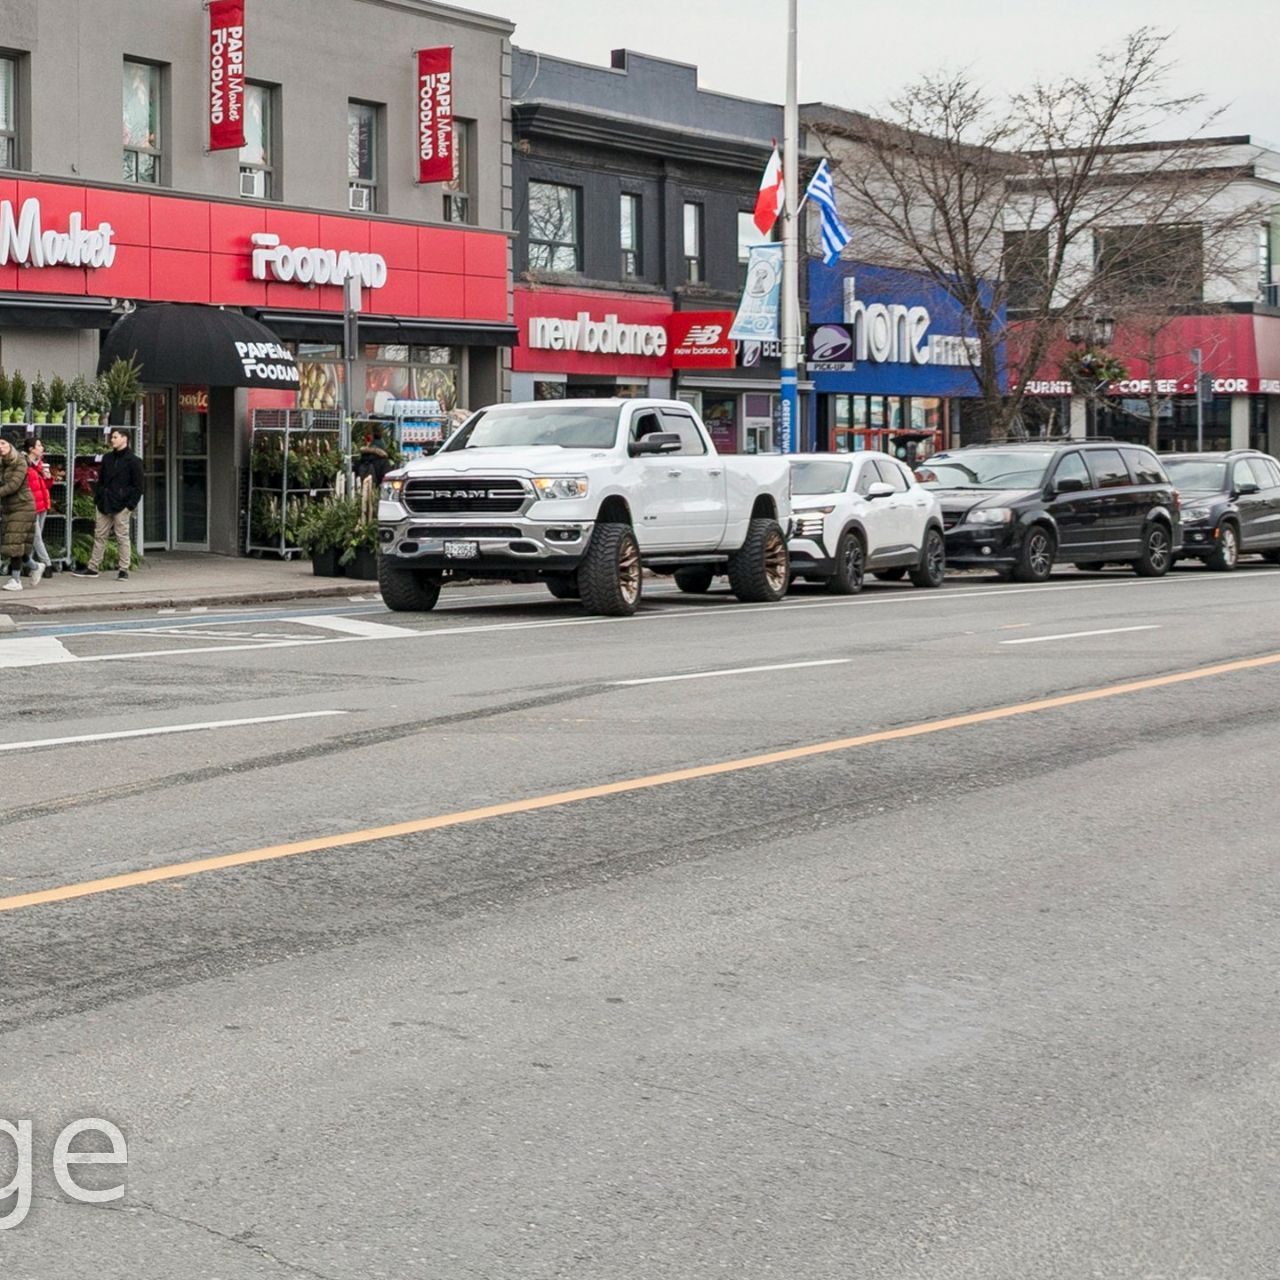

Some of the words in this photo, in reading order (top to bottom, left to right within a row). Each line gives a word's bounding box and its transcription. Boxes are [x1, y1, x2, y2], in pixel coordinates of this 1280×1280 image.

[228, 26, 243, 75] PAPE
[211, 27, 227, 124] FOODLAND
[436, 72, 450, 117] PAPE
[228, 77, 243, 122] Market
[420, 73, 436, 160] FOODLAND
[436, 118, 451, 158] Market
[251, 232, 387, 288] FOODLAND
[234, 341, 277, 359] PAPE
[529, 317, 579, 349] new
[576, 312, 667, 357] balance
[762, 340, 782, 357] BEL
[435, 490, 485, 498] RAM
